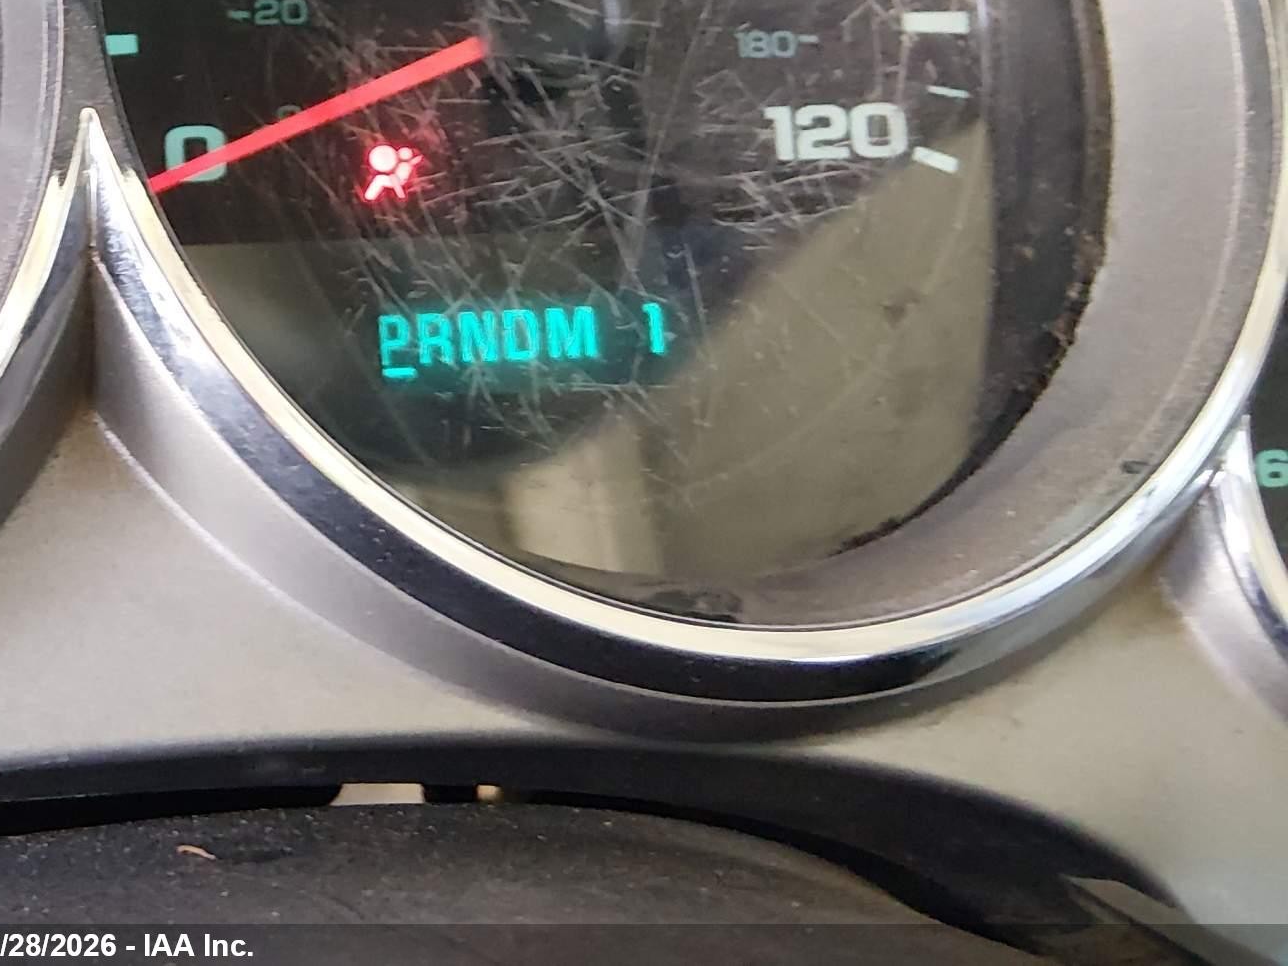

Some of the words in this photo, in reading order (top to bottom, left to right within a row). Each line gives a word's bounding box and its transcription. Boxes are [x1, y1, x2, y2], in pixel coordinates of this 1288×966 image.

[733, 29, 797, 59] 180
[164, 125, 228, 183] 0
[765, 102, 908, 162] 120
[378, 304, 599, 368] PRNDM
[642, 301, 666, 356] 1
